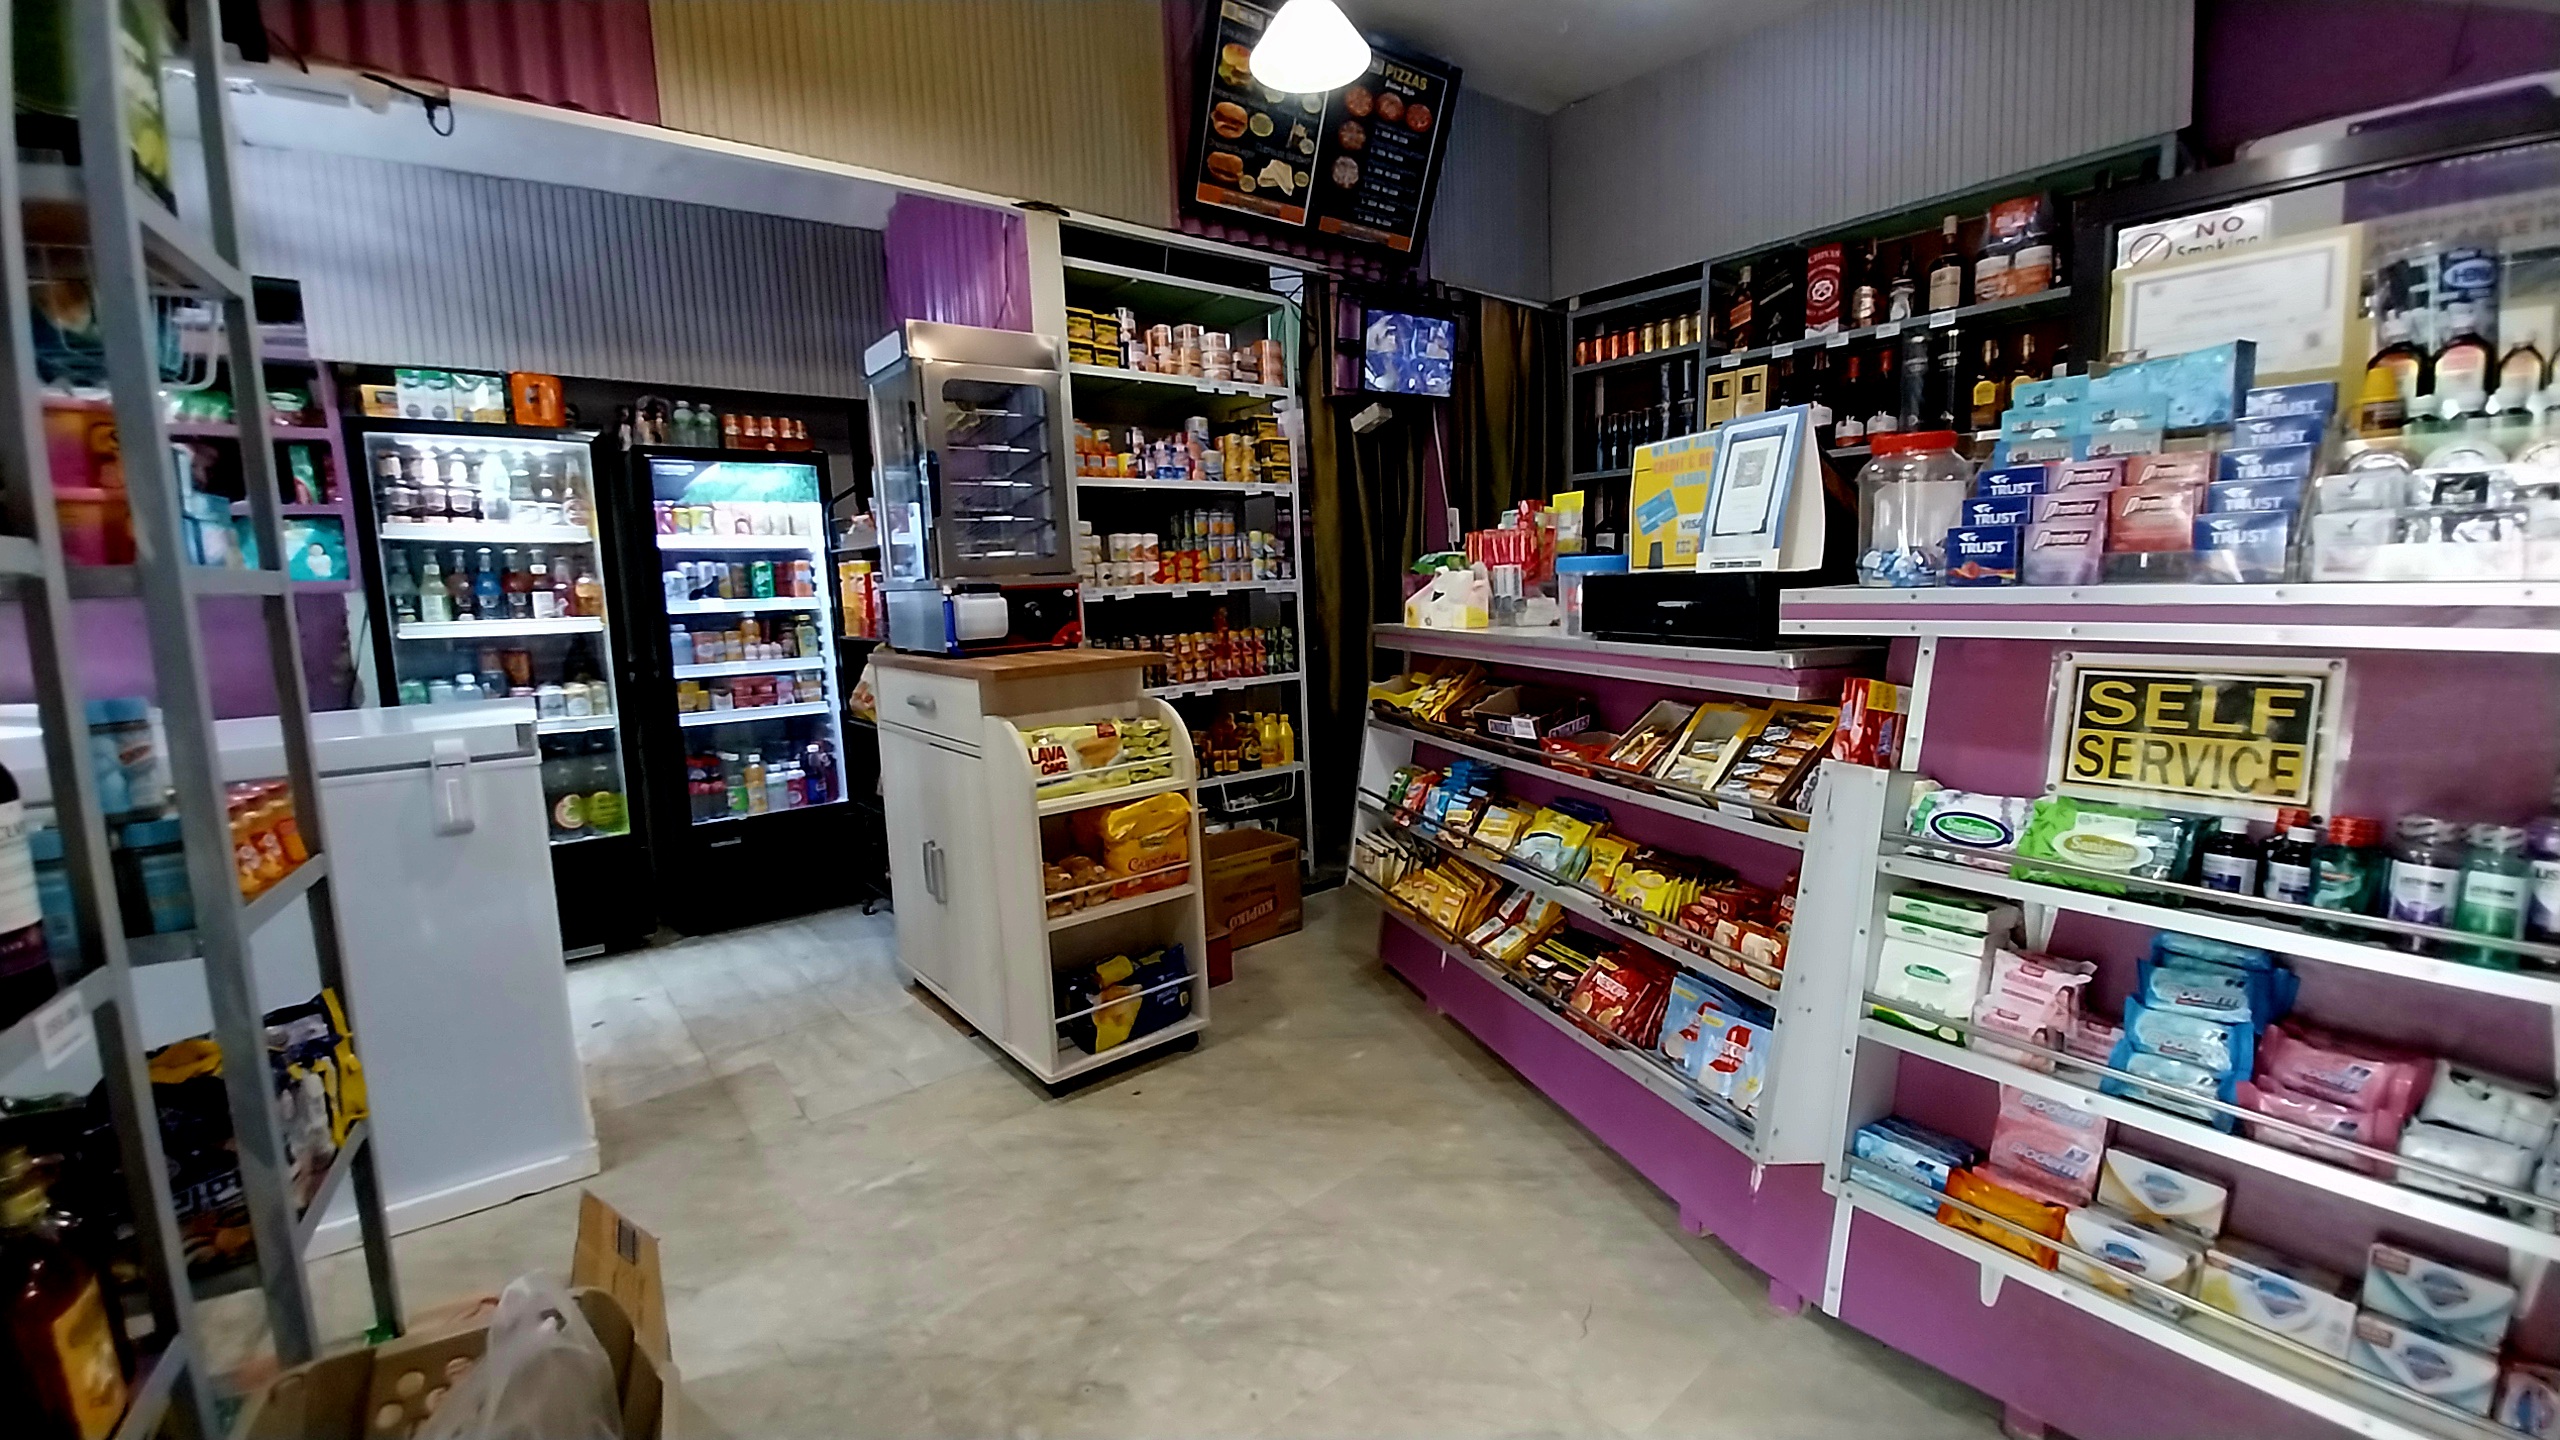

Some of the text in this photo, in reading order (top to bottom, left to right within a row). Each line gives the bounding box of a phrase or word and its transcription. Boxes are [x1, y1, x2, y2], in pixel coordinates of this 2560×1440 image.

[1385, 64, 1428, 90] PIZZAS
[2195, 216, 2245, 239] NO
[2266, 399, 2318, 414] TRUST
[2250, 430, 2306, 446] TRUST
[2236, 462, 2294, 479] TRUST
[1990, 481, 2042, 497] TRUST
[2225, 496, 2283, 511] TRUST
[1974, 511, 2026, 526] TRUST
[2211, 529, 2269, 545] TRUST
[1959, 540, 2008, 555] TRUST
[2084, 680, 2306, 735] SELF
[1028, 746, 1067, 765] LAVA
[1042, 760, 1069, 776] CAKE
[2074, 734, 2301, 797] SERVICE
